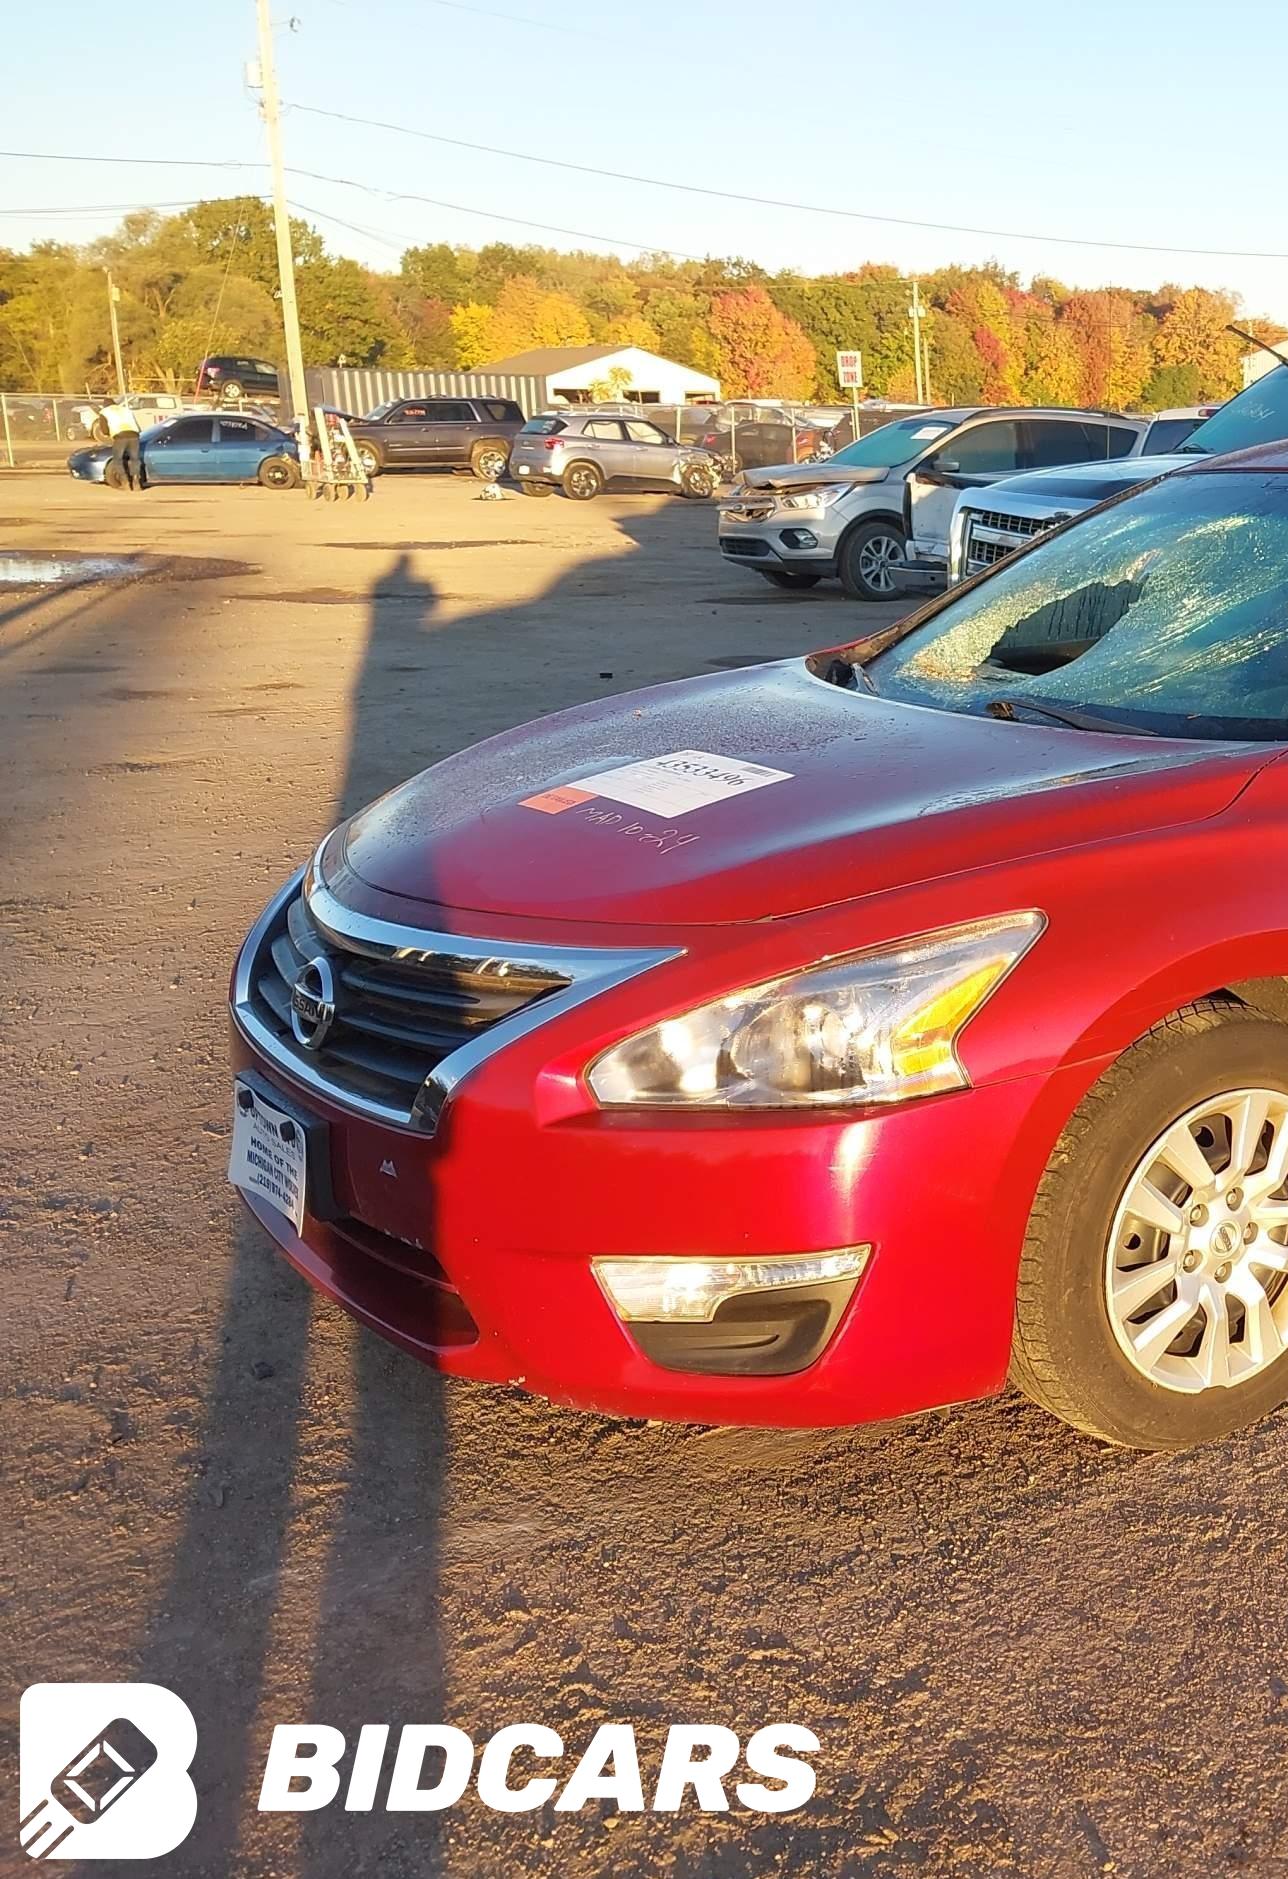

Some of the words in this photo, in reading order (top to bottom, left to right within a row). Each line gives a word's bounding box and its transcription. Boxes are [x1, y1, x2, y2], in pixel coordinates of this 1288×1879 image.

[841, 355, 857, 367] DROP
[656, 759, 745, 786] 43533496
[246, 1149, 274, 1176] MICHIGAN
[250, 1135, 274, 1159] HOME
[274, 1155, 285, 1168] OF
[285, 1160, 298, 1181] THE
